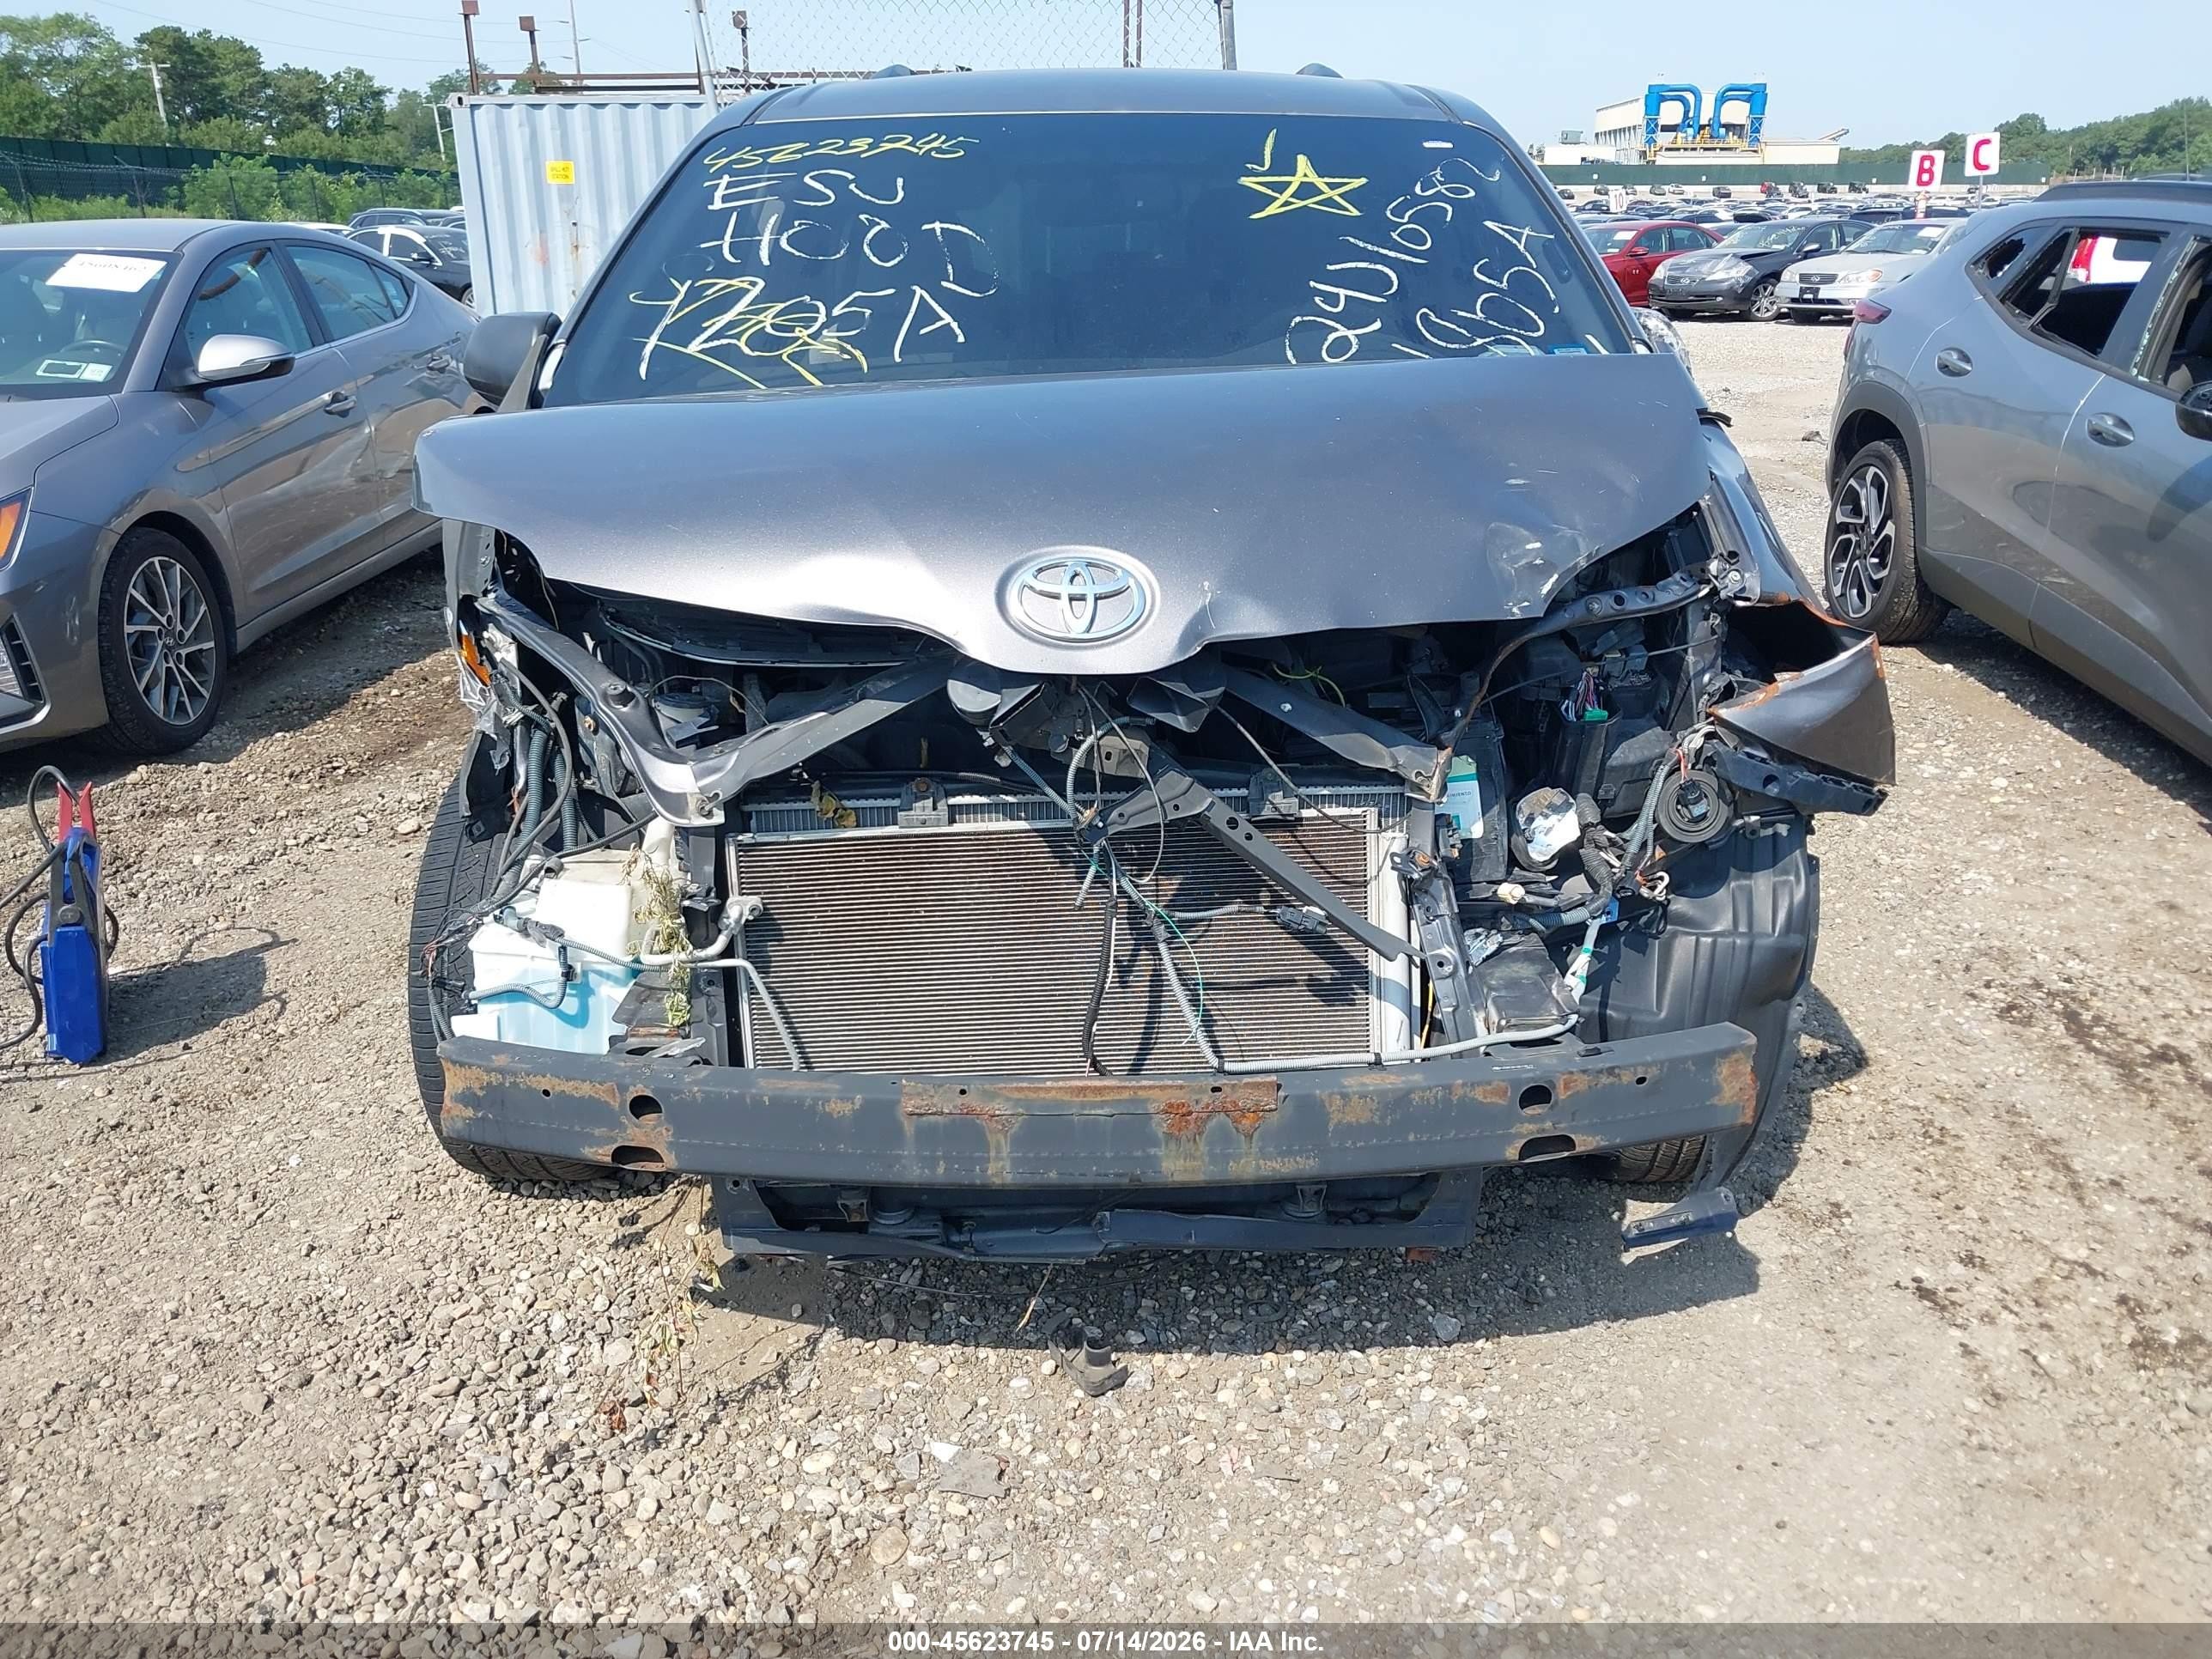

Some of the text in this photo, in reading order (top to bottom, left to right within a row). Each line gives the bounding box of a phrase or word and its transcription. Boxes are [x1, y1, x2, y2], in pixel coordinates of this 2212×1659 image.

[1916, 155, 1936, 186] B
[1972, 138, 1992, 171] C
[1614, 192, 1624, 210] 10
[699, 209, 999, 298] HOOD
